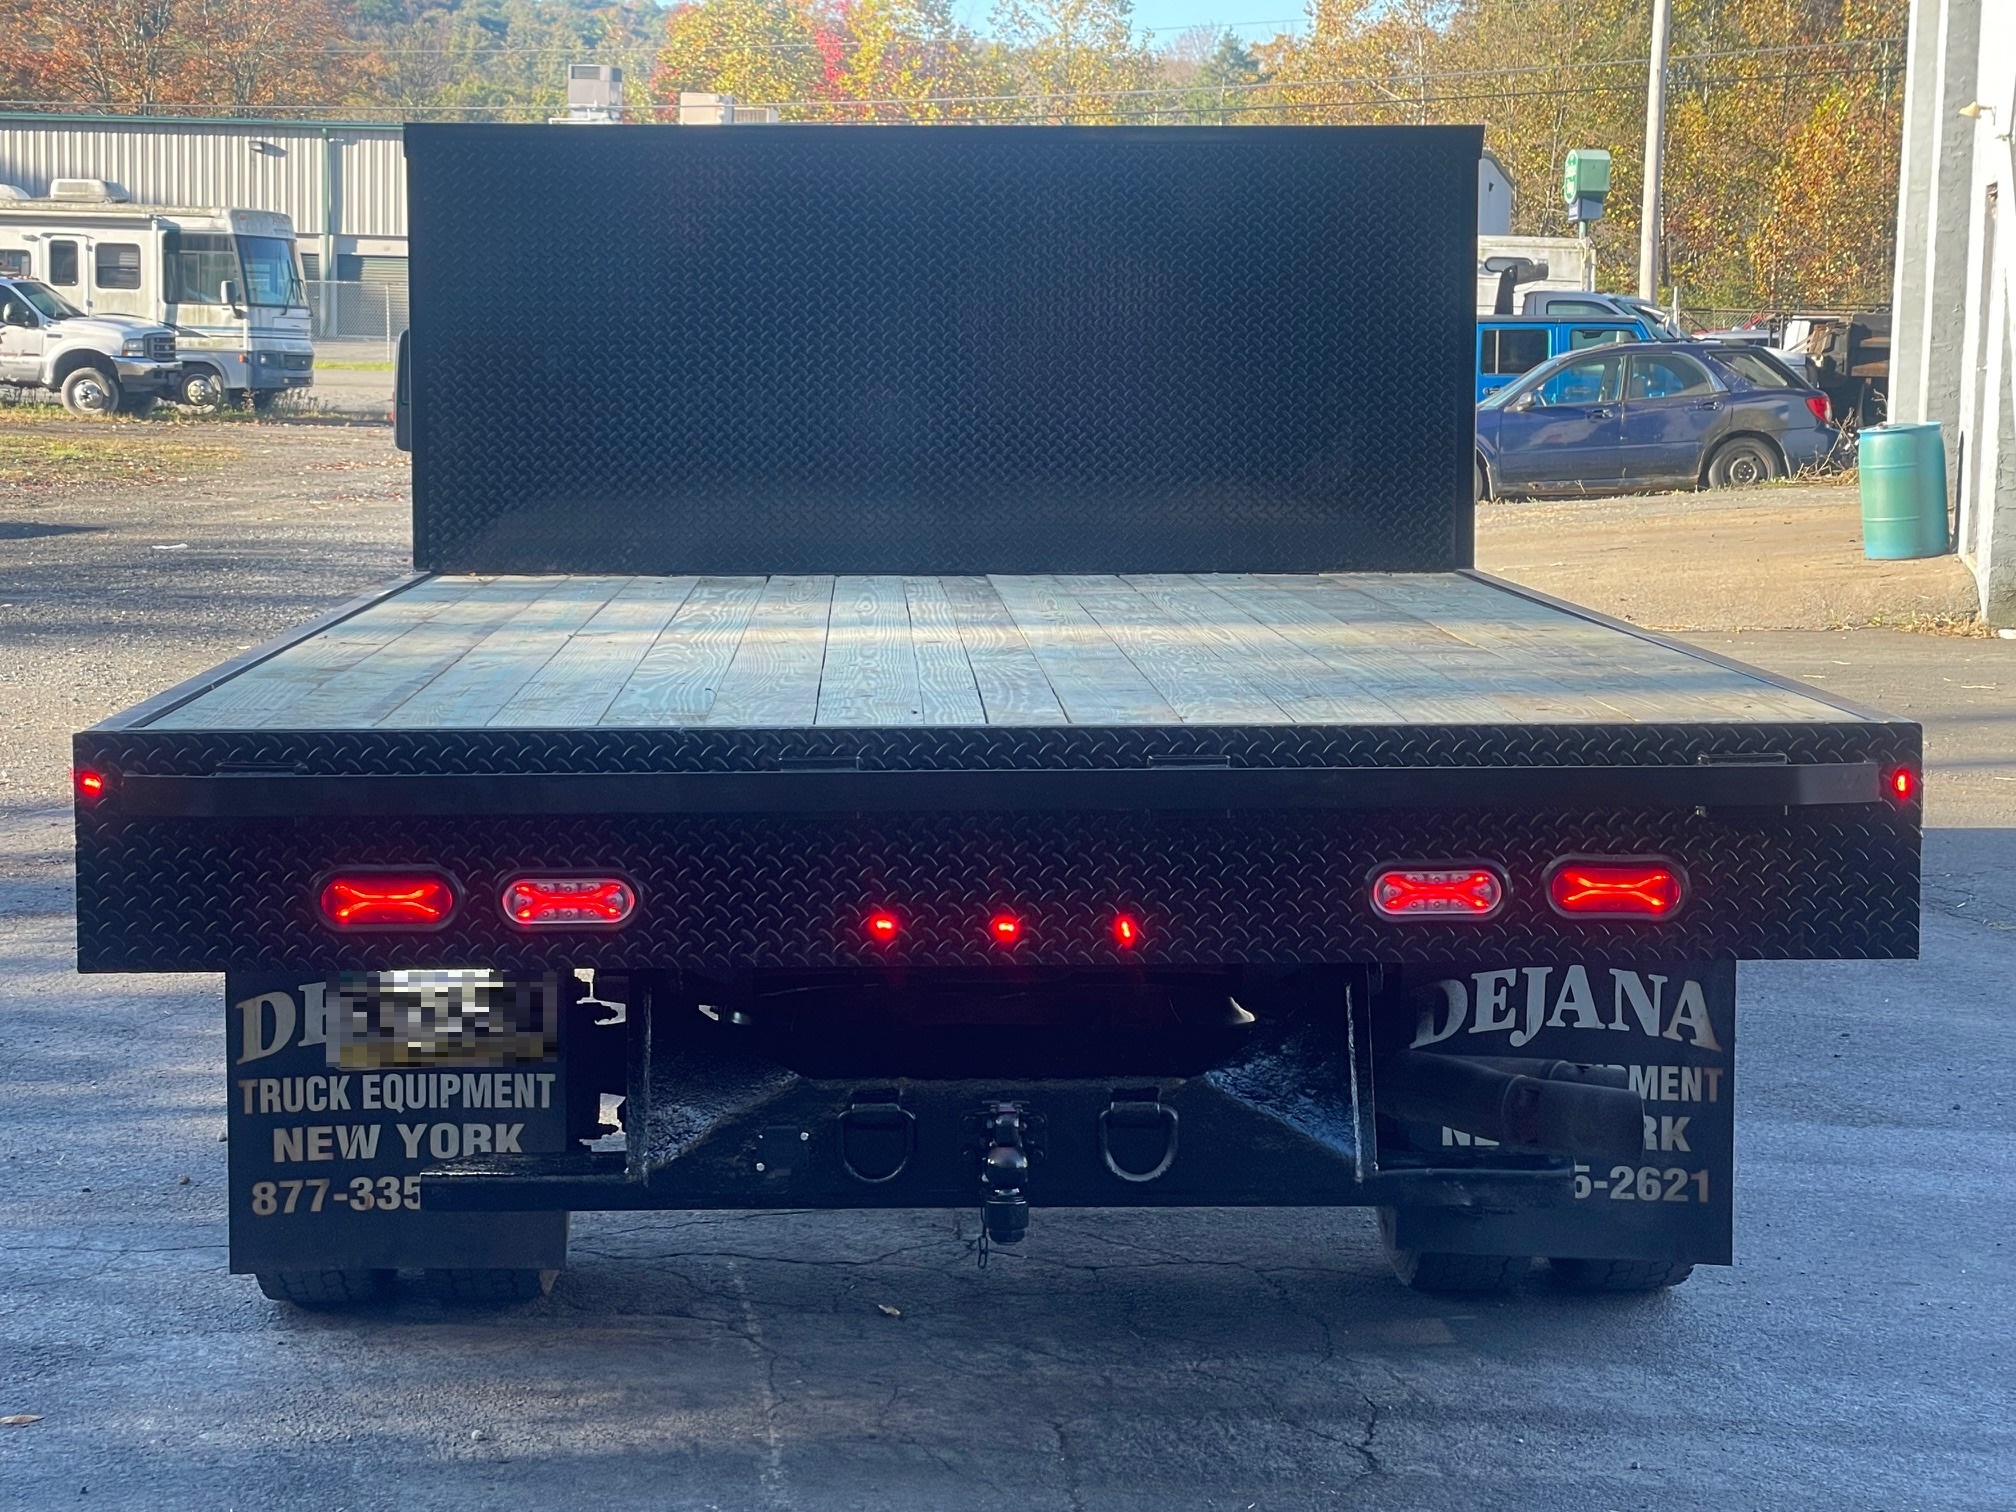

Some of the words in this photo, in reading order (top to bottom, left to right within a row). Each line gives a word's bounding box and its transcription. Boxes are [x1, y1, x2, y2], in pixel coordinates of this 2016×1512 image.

[1409, 965, 1723, 1052] DEJANA
[237, 1075, 351, 1115] TRUCK
[362, 1073, 556, 1113] EQUIPMENT
[273, 1124, 381, 1163] NEW
[396, 1122, 525, 1160] YORK
